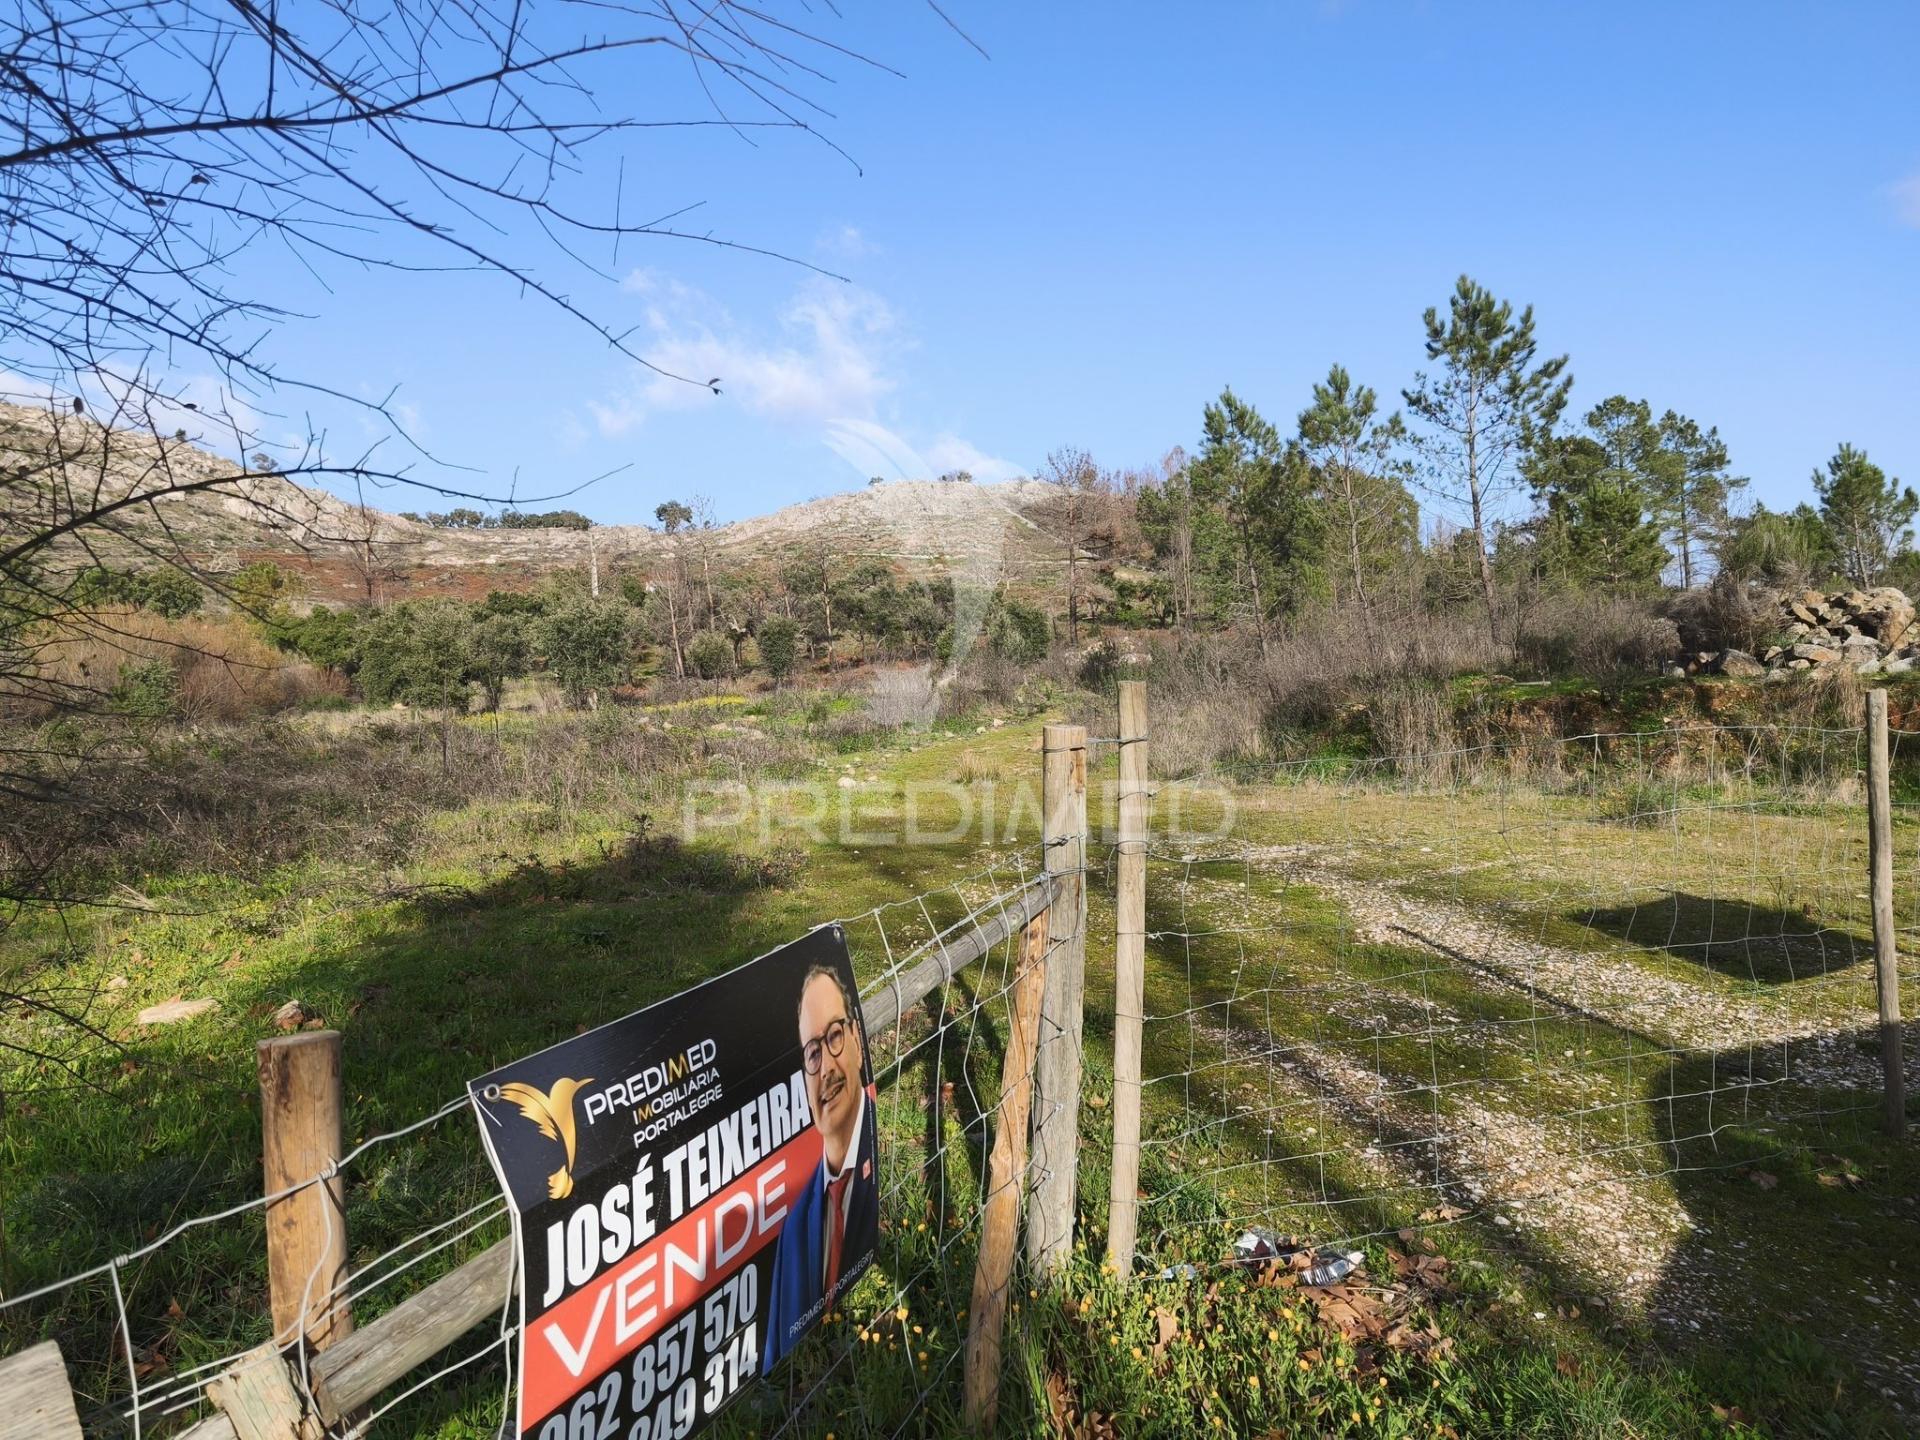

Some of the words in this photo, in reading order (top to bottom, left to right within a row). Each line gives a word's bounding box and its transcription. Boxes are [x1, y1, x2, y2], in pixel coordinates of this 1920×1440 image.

[583, 1038, 717, 1126] PREDIMED
[632, 1067, 721, 1126] IMOBILIÁRIA
[633, 1083, 723, 1149] PORTALEGRE
[543, 1152, 656, 1309] JOSÉ
[662, 1069, 812, 1222] TEIXEIRA
[543, 1158, 788, 1377] VENDE
[631, 1308, 697, 1413] 857
[703, 1263, 758, 1353] 570
[703, 1321, 759, 1414] 314
